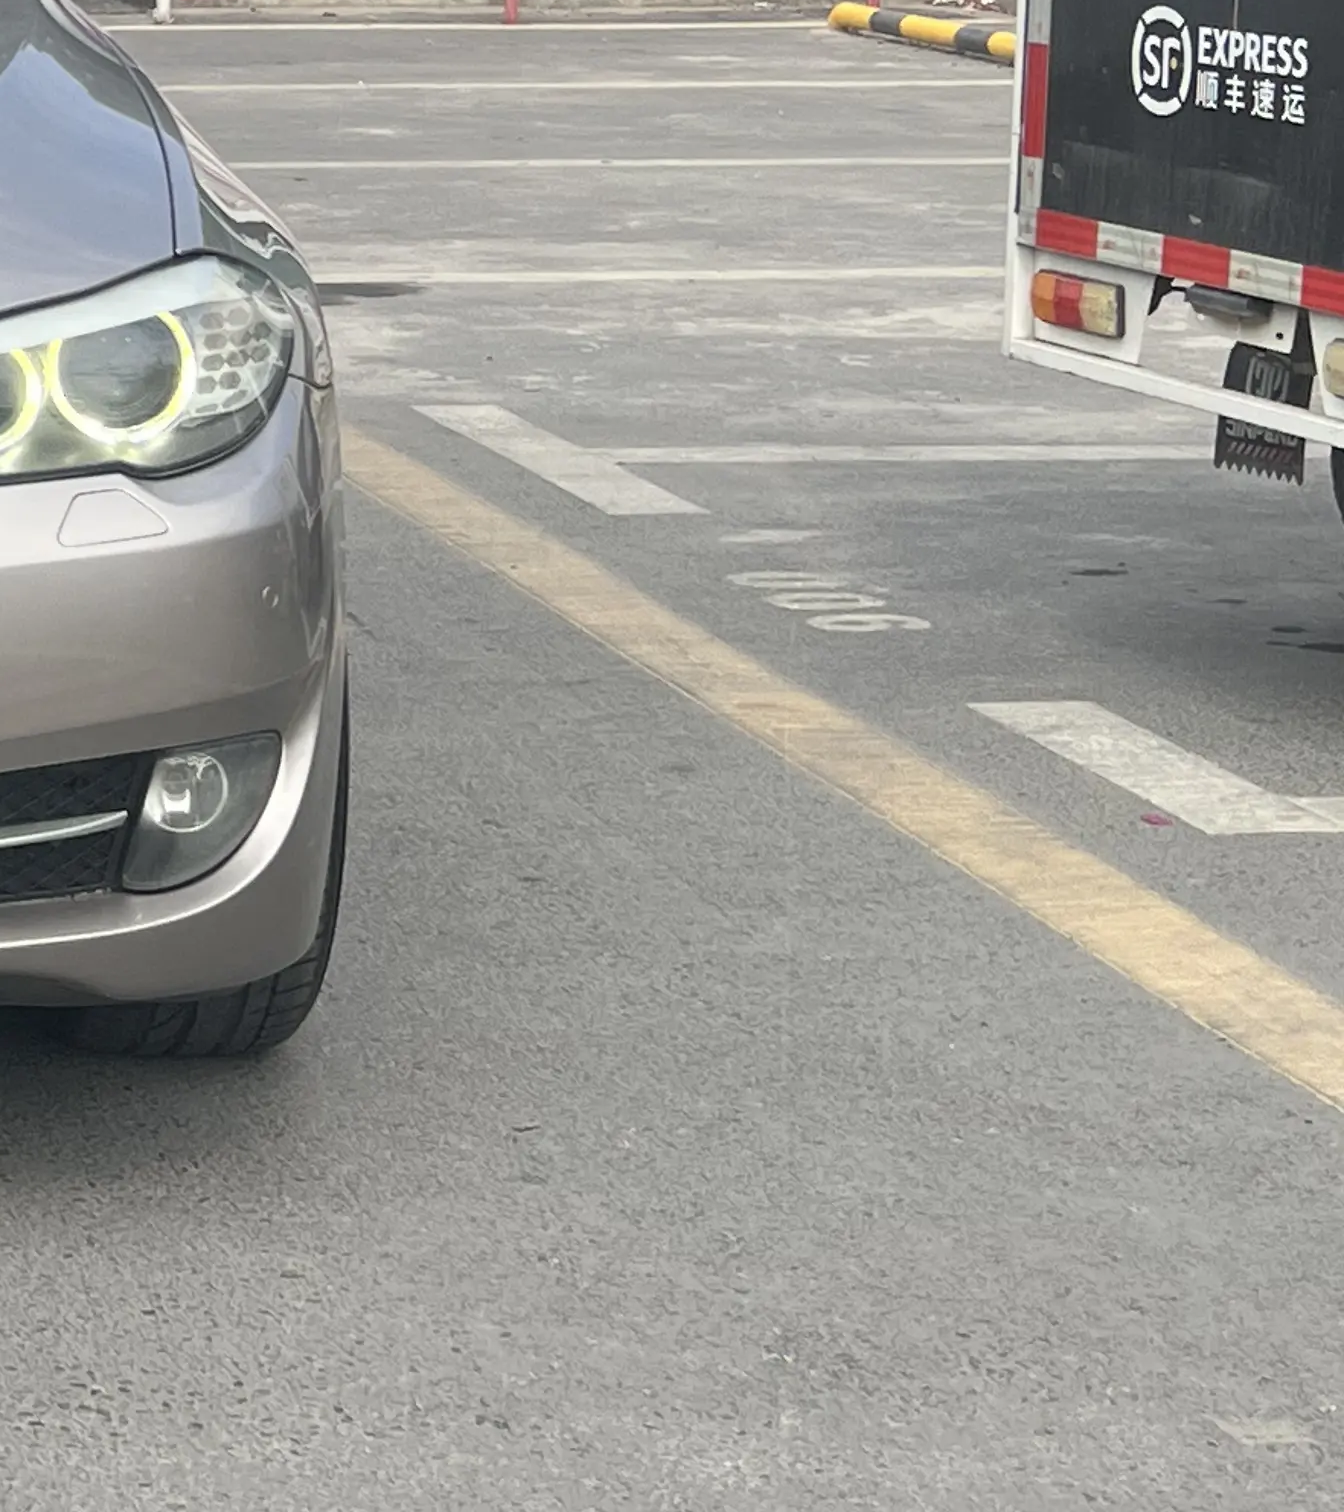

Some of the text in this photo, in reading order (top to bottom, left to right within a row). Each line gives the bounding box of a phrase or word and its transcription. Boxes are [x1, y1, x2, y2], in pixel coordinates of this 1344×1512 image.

[1197, 25, 1309, 79] EXPRESS
[1194, 70, 1306, 125] 顺丰速运
